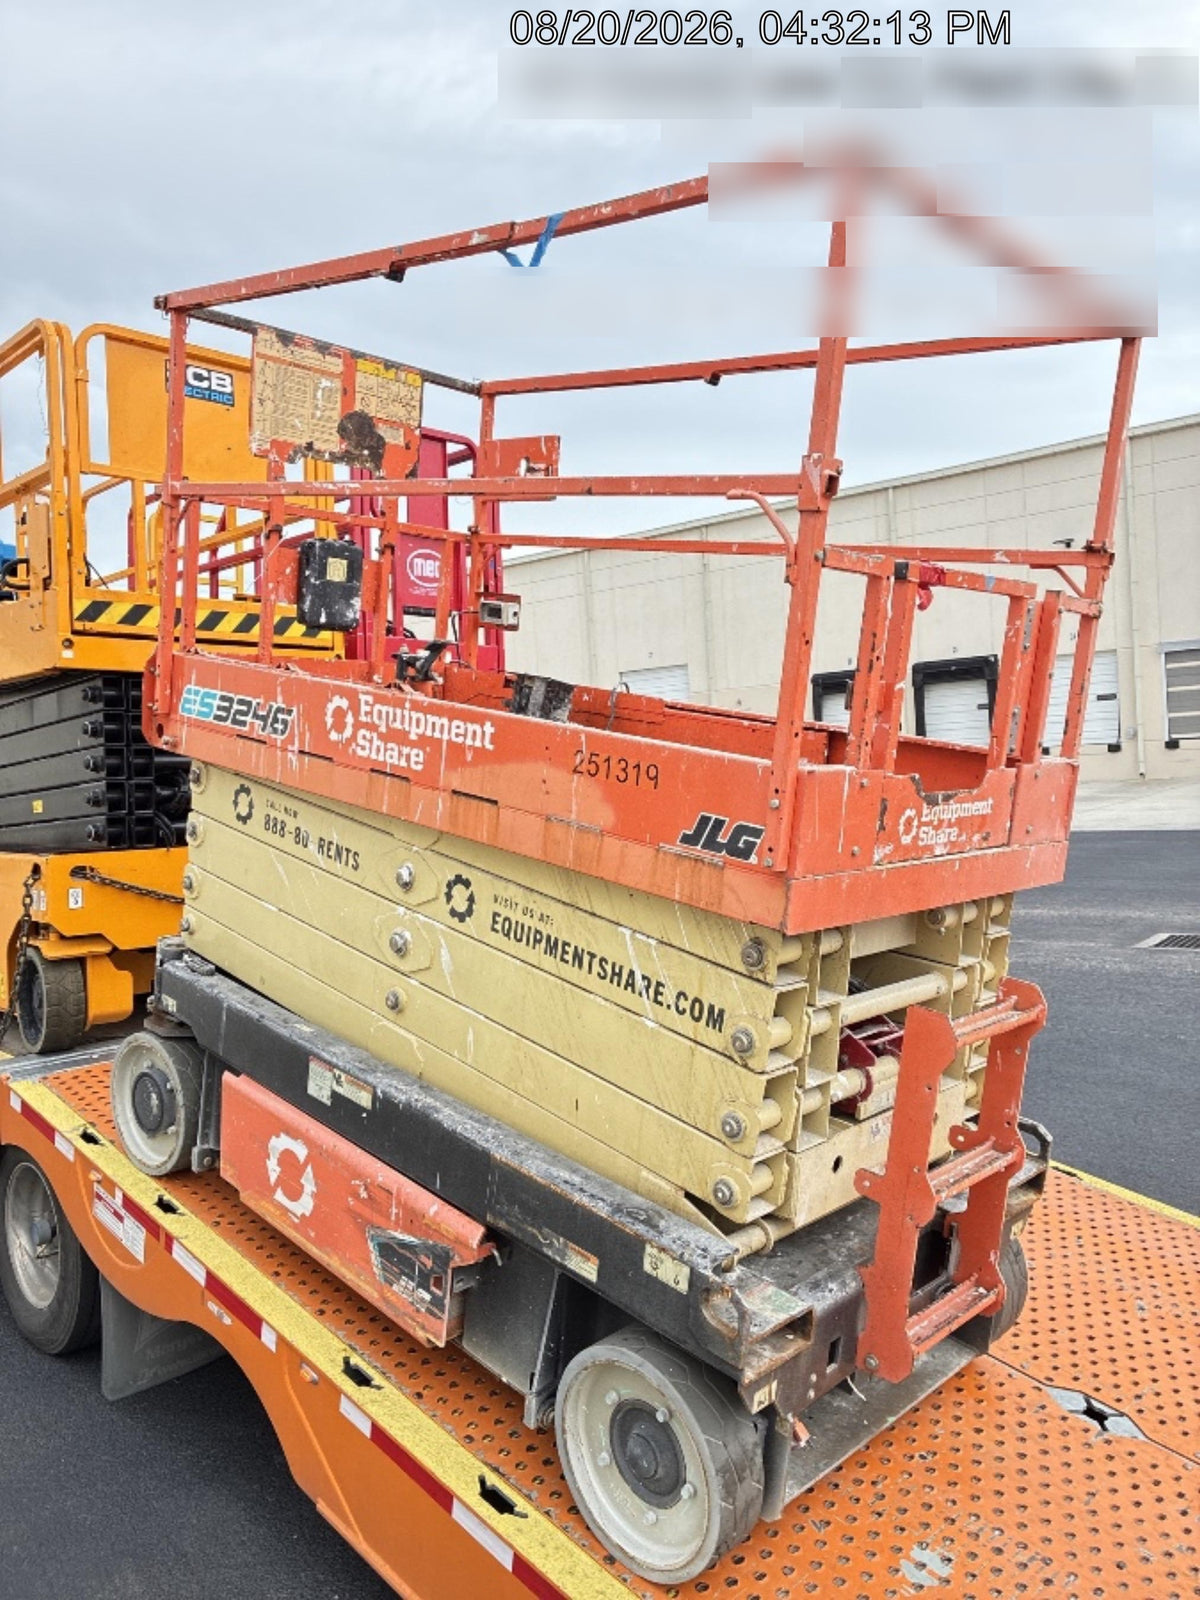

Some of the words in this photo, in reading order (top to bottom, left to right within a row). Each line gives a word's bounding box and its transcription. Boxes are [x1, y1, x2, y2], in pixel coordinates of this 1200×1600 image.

[167, 360, 232, 394] CB
[184, 386, 233, 404] ECTRIC
[179, 685, 293, 740] ES3246
[358, 691, 495, 750] Equipment
[356, 729, 425, 771] Share
[572, 750, 660, 790] 251319
[920, 797, 994, 825] Equipment
[677, 811, 766, 862] JLG
[918, 827, 959, 846] Share
[490, 911, 726, 1034] EQUIPMENTSHARE.COM
